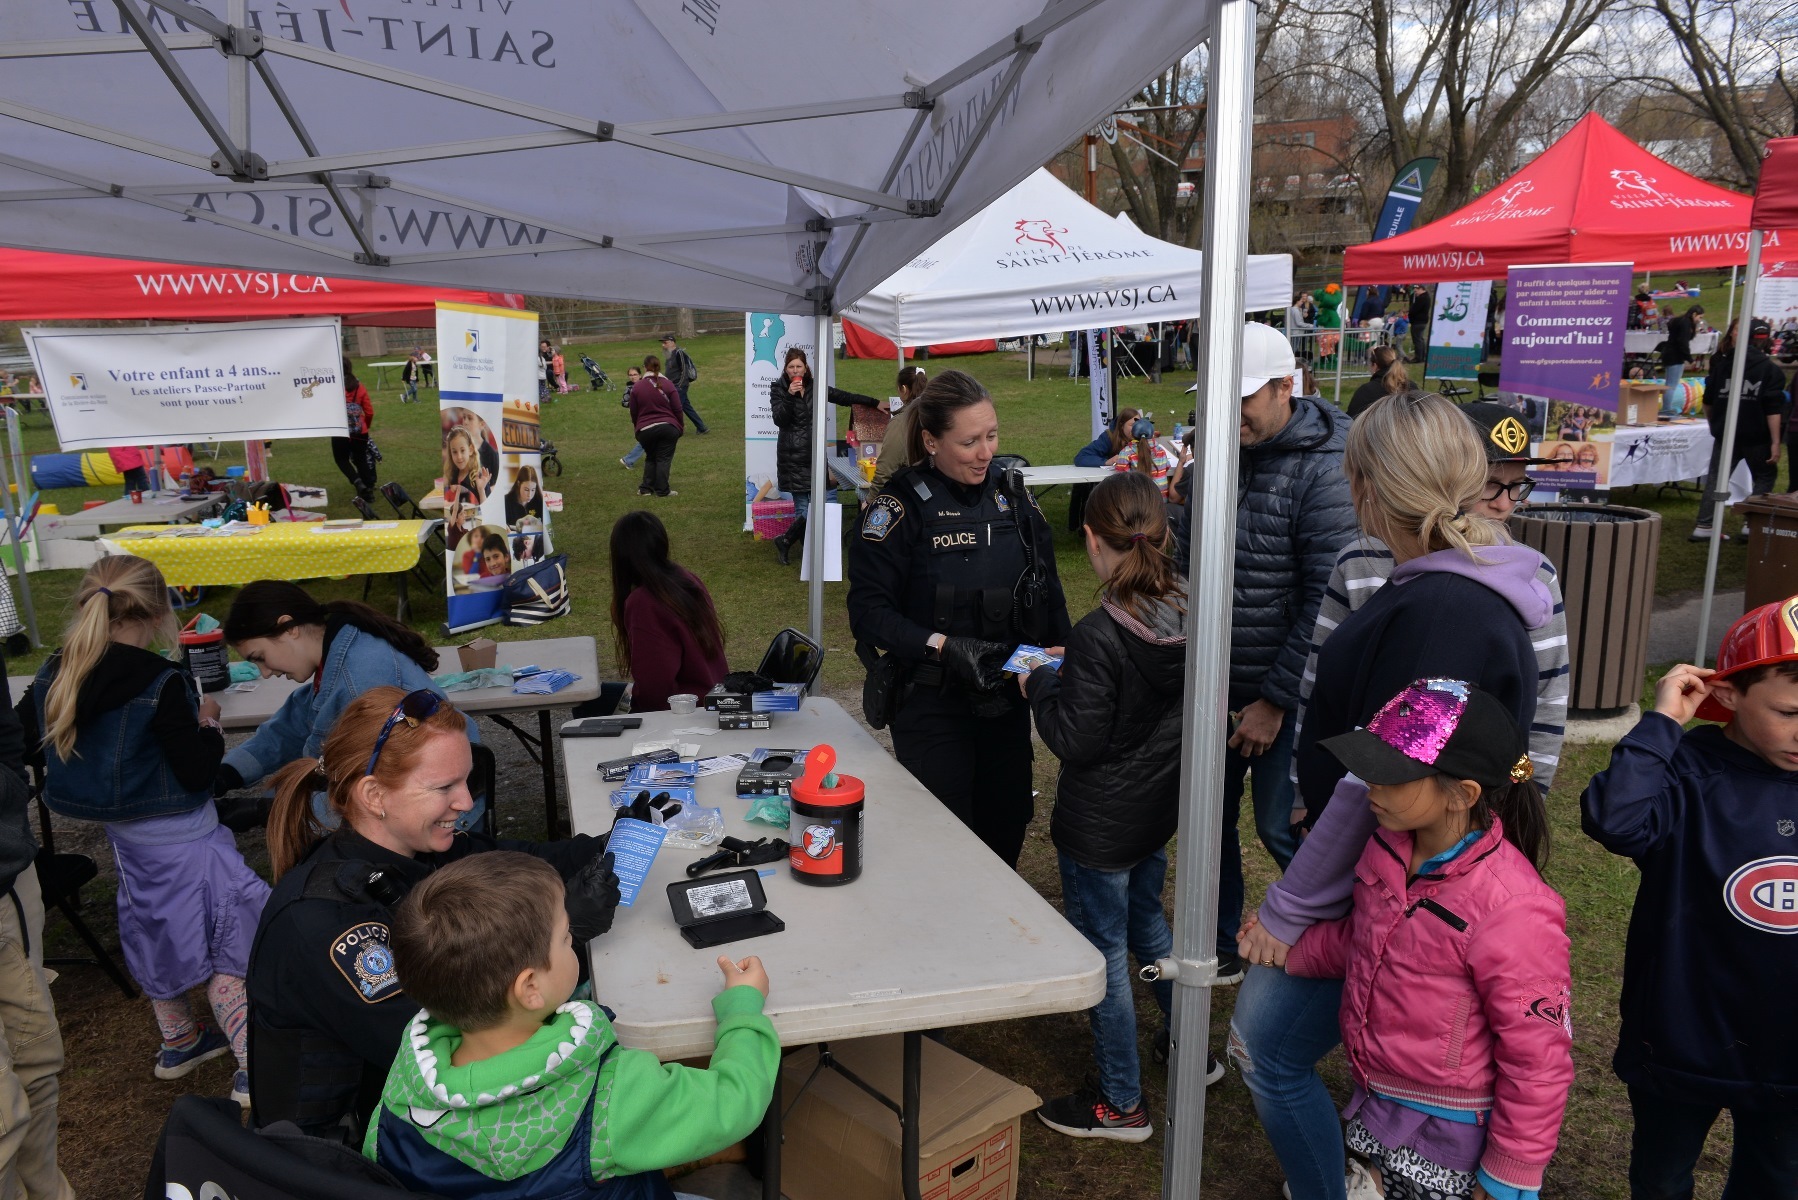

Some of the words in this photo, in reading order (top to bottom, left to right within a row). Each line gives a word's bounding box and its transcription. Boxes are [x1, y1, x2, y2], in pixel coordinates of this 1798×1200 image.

[1609, 198, 1735, 209] SAINT-JÉRÔME
[996, 249, 1154, 269] SAINT-JÉRÔME
[1006, 247, 1045, 256] VILLE
[1403, 250, 1485, 272] WWW.VSJ.CA
[134, 273, 332, 299] WWW.VSJ.CA
[1557, 279, 1590, 288] quelques
[1030, 284, 1178, 316] WWW.VSJ.CA
[1516, 290, 1529, 298] par
[1530, 289, 1562, 297] semaine
[1564, 289, 1582, 298] pour
[1519, 299, 1543, 307] enfant
[1516, 314, 1612, 327] Commencez
[1511, 331, 1603, 348] aujourd'hui
[1607, 332, 1613, 344] !
[107, 368, 156, 383] Votre
[160, 366, 211, 380] enfant
[215, 368, 224, 378] a
[229, 364, 237, 378] 4
[242, 366, 281, 377] ans...
[293, 374, 336, 388] partout
[131, 387, 150, 397] Les
[153, 383, 192, 395] ateliers
[194, 382, 266, 394] Passe-Partout
[160, 399, 182, 408] sont
[185, 397, 210, 408] pour
[213, 397, 236, 406] vous
[872, 496, 902, 513] POLICE
[933, 532, 976, 549] POLICE
[335, 926, 388, 956] POLICE
